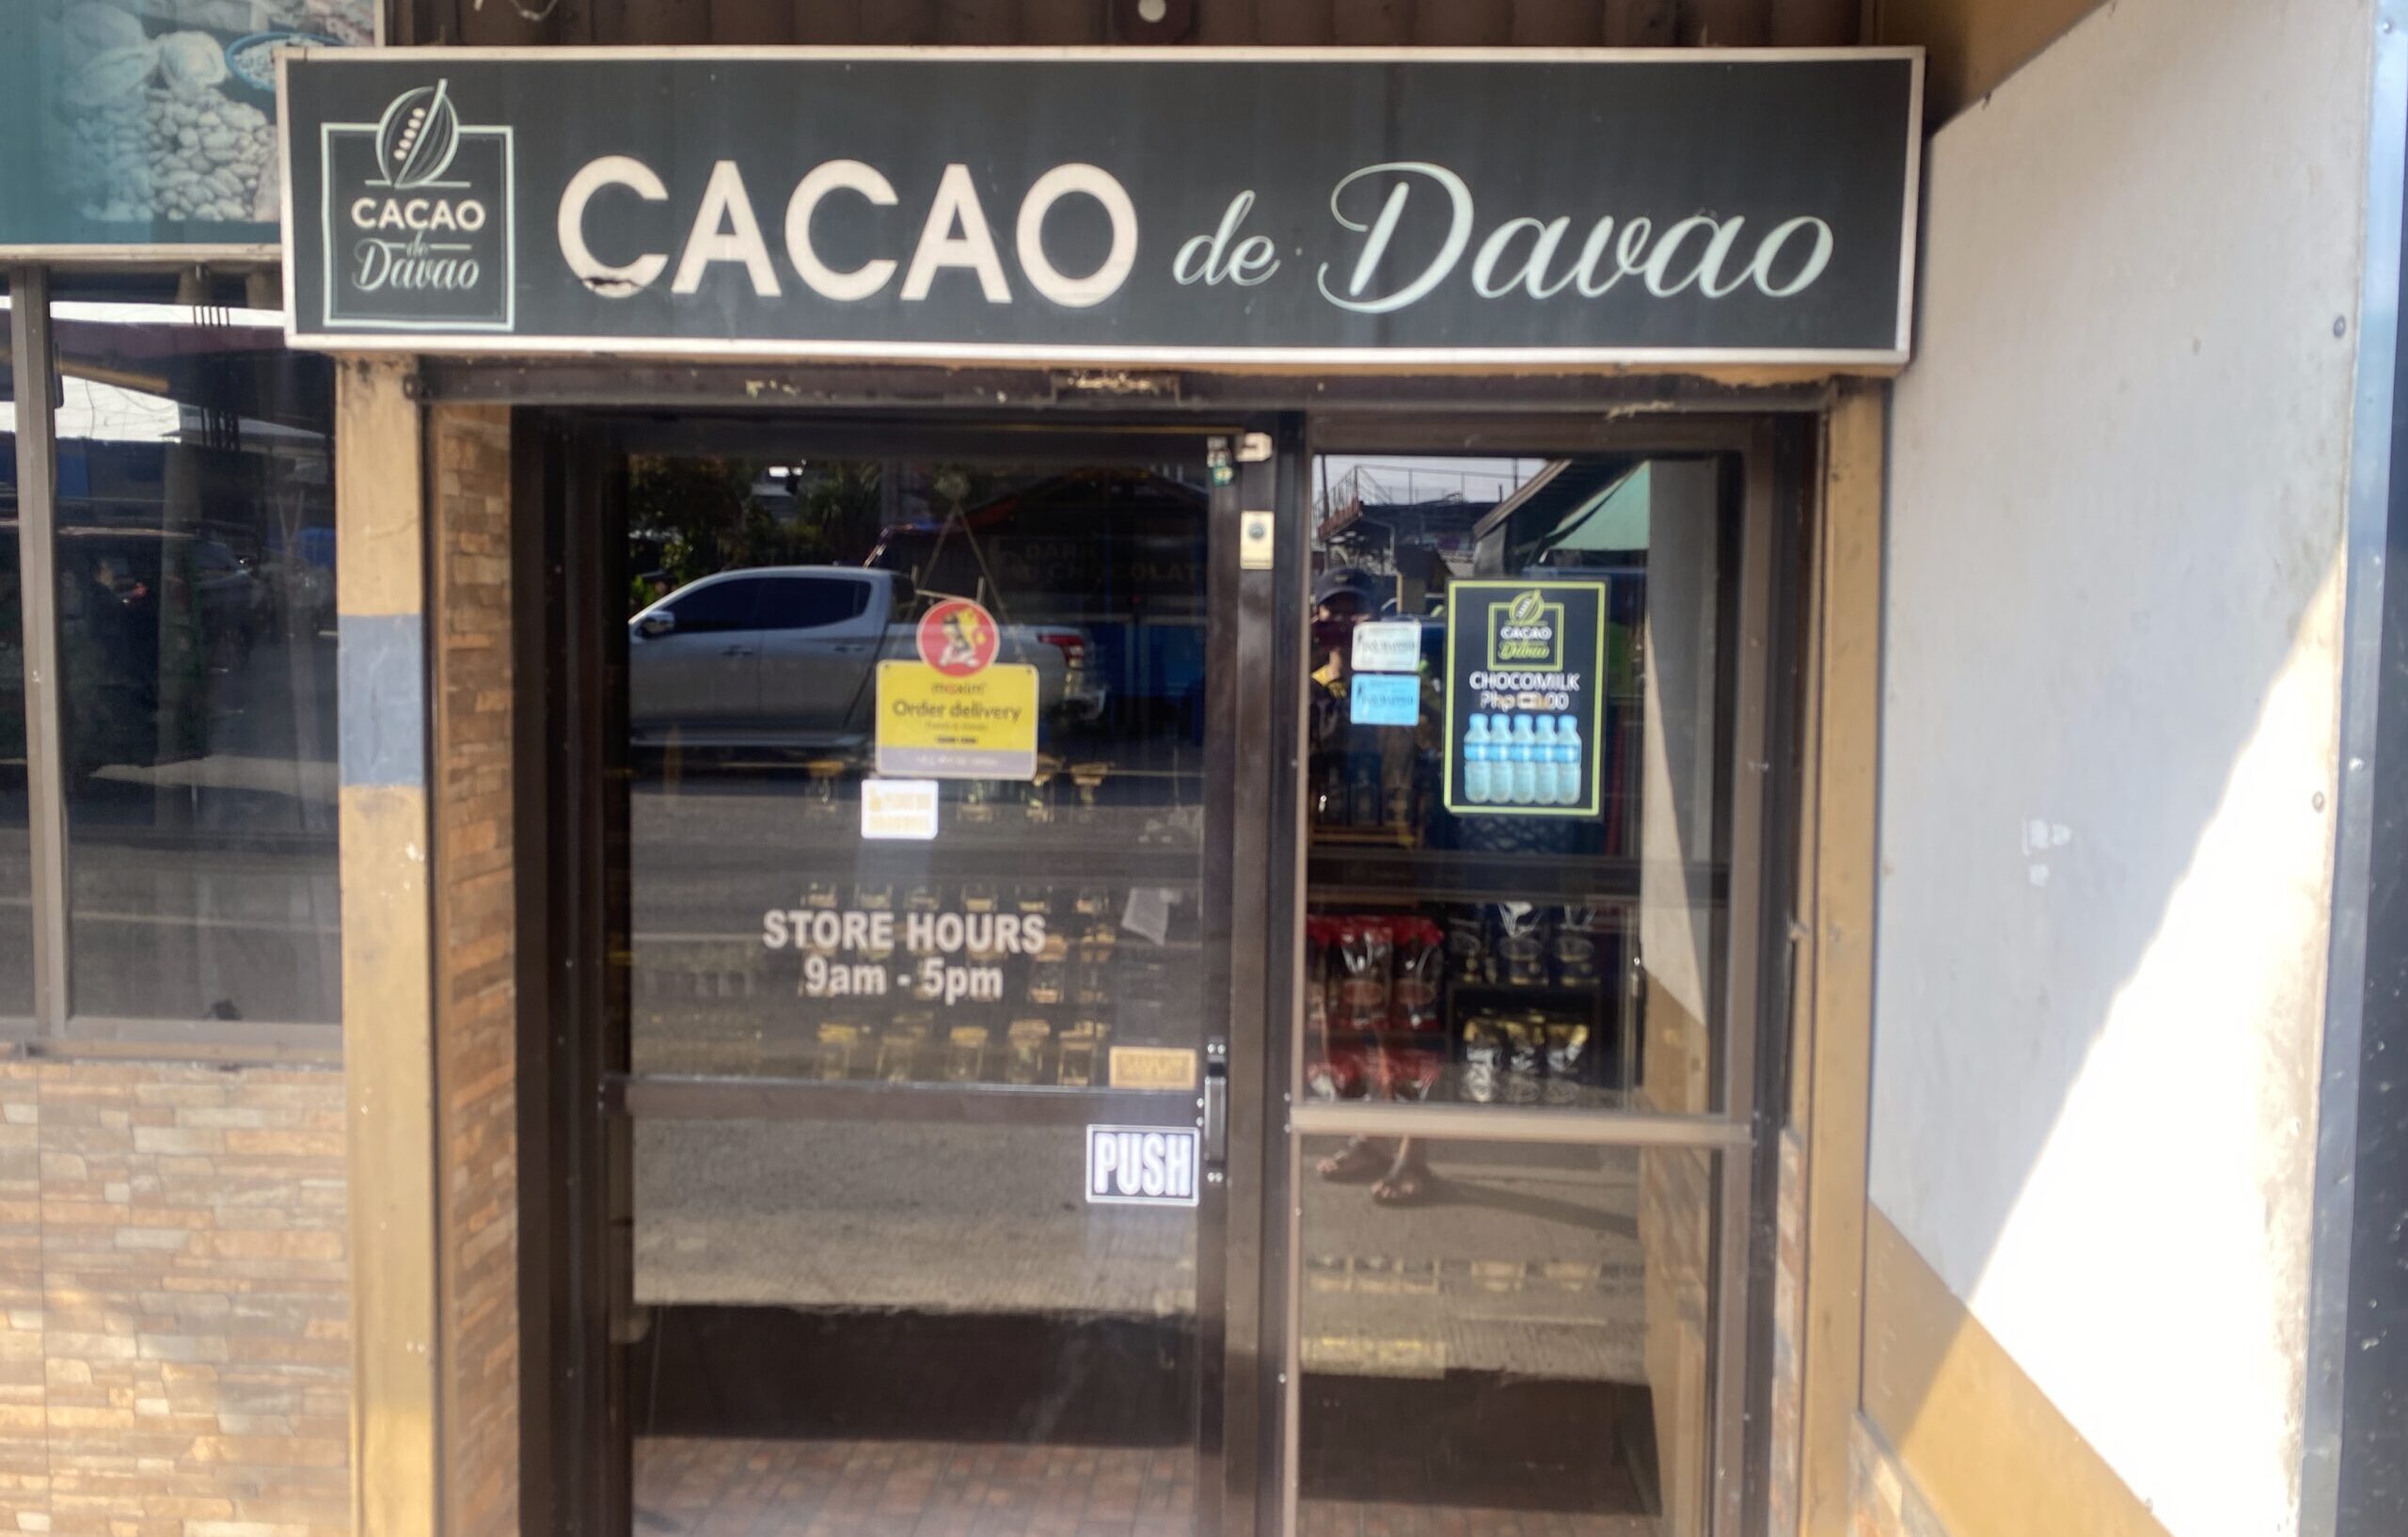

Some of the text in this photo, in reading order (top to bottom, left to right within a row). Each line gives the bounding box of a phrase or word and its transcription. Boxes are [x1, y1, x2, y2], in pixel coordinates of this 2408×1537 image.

[351, 197, 485, 231] CACAO
[557, 153, 1833, 313] CACAO de Davao
[352, 238, 480, 291] Davao
[1500, 626, 1552, 640] CACAO
[1469, 671, 1580, 691] CHOCOMILK
[893, 699, 1022, 725] Order delivery
[1481, 690, 1515, 712] Php
[763, 909, 1047, 954] STORE HOURS
[803, 955, 886, 997] 9am
[920, 958, 1004, 1006] 5pm
[1093, 1132, 1192, 1196] PUSH
